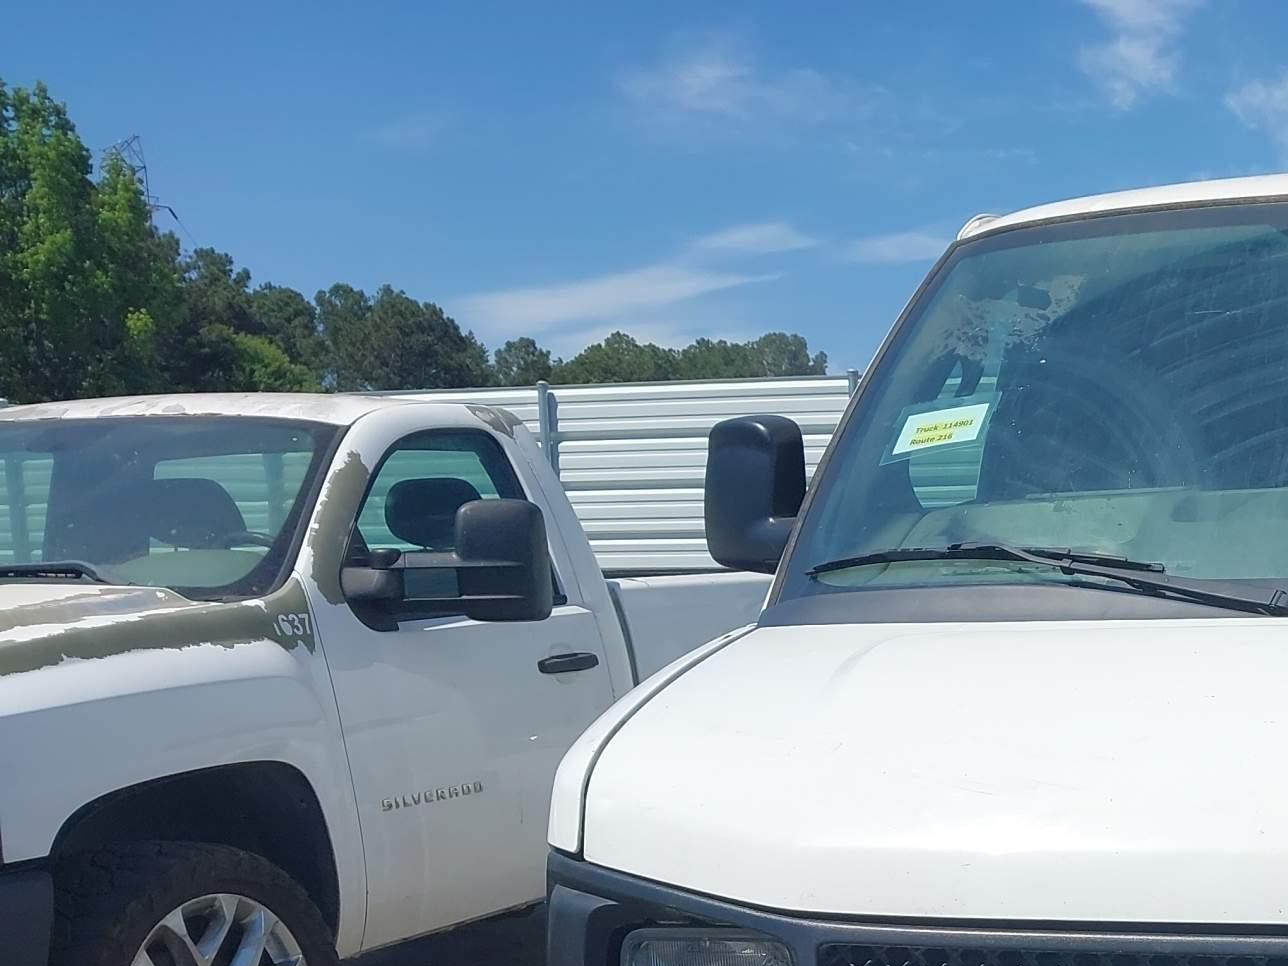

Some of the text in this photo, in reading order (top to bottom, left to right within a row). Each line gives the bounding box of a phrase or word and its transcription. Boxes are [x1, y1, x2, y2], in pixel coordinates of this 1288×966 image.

[915, 424, 938, 434] Truck
[910, 433, 953, 445] Route 216
[381, 781, 483, 812] SILVERADO
